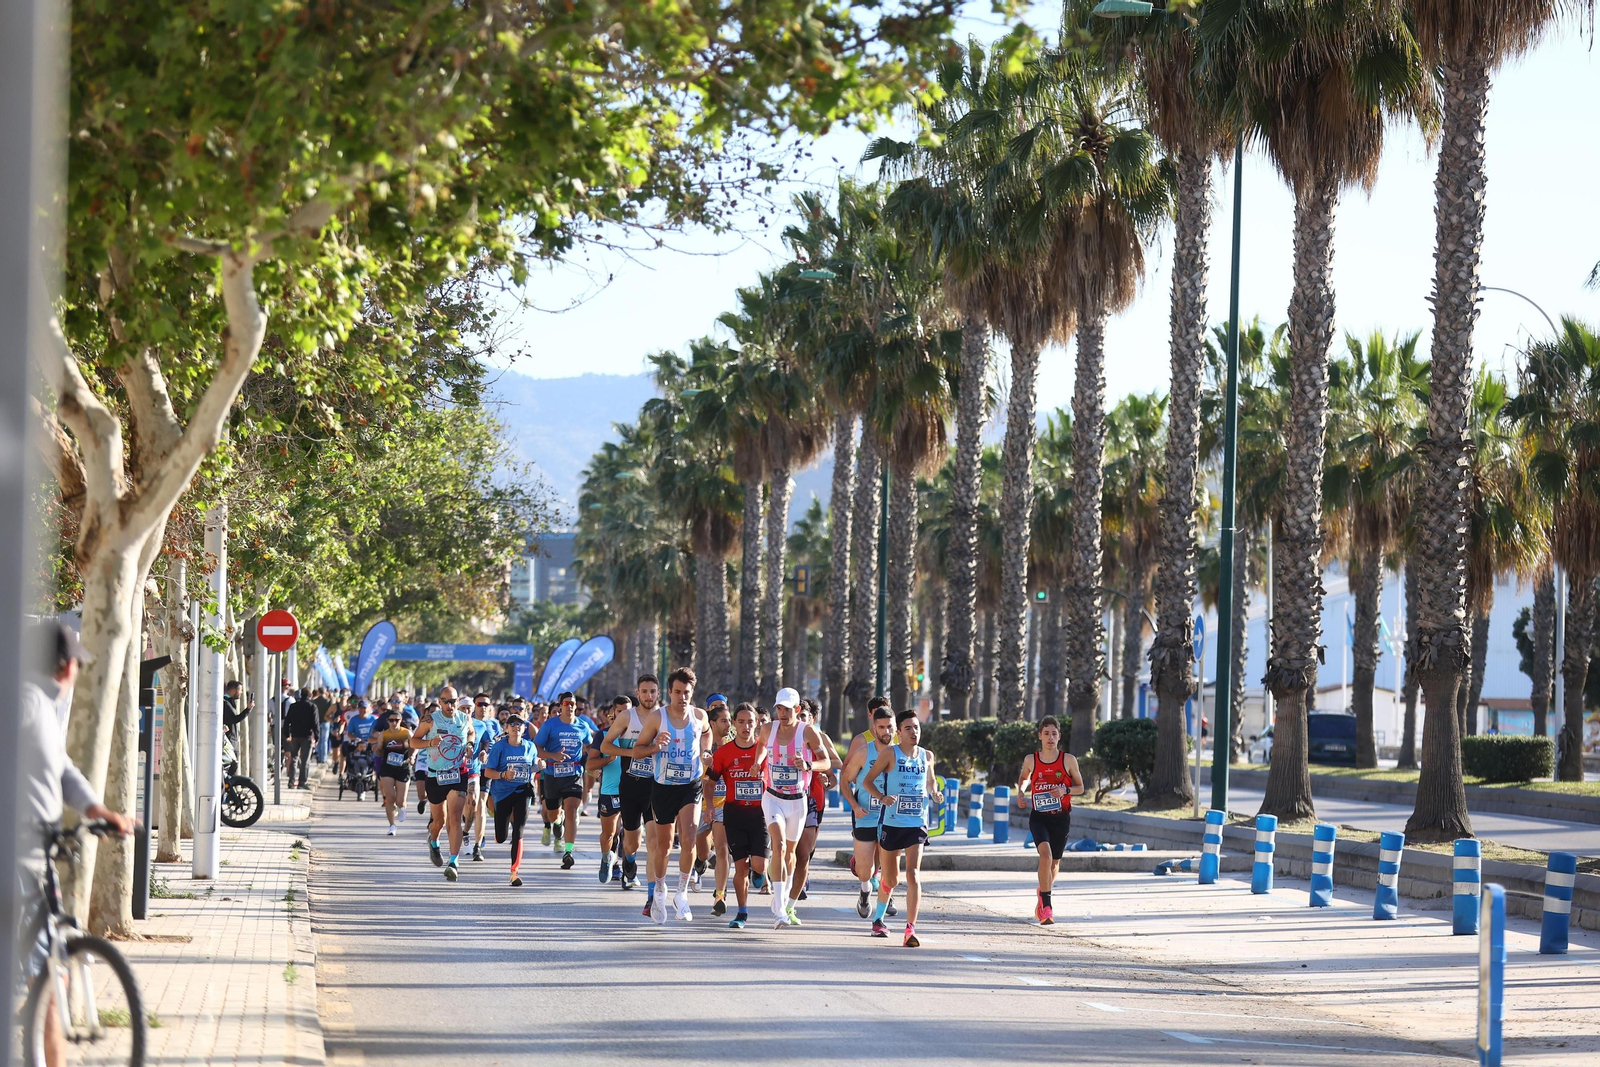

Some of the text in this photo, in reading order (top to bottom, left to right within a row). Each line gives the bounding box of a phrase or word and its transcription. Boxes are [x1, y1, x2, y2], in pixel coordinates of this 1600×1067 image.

[359, 633, 388, 679] mayoral
[487, 647, 527, 658] mayoral
[561, 647, 605, 690] mayoral
[898, 764, 926, 775] nerja
